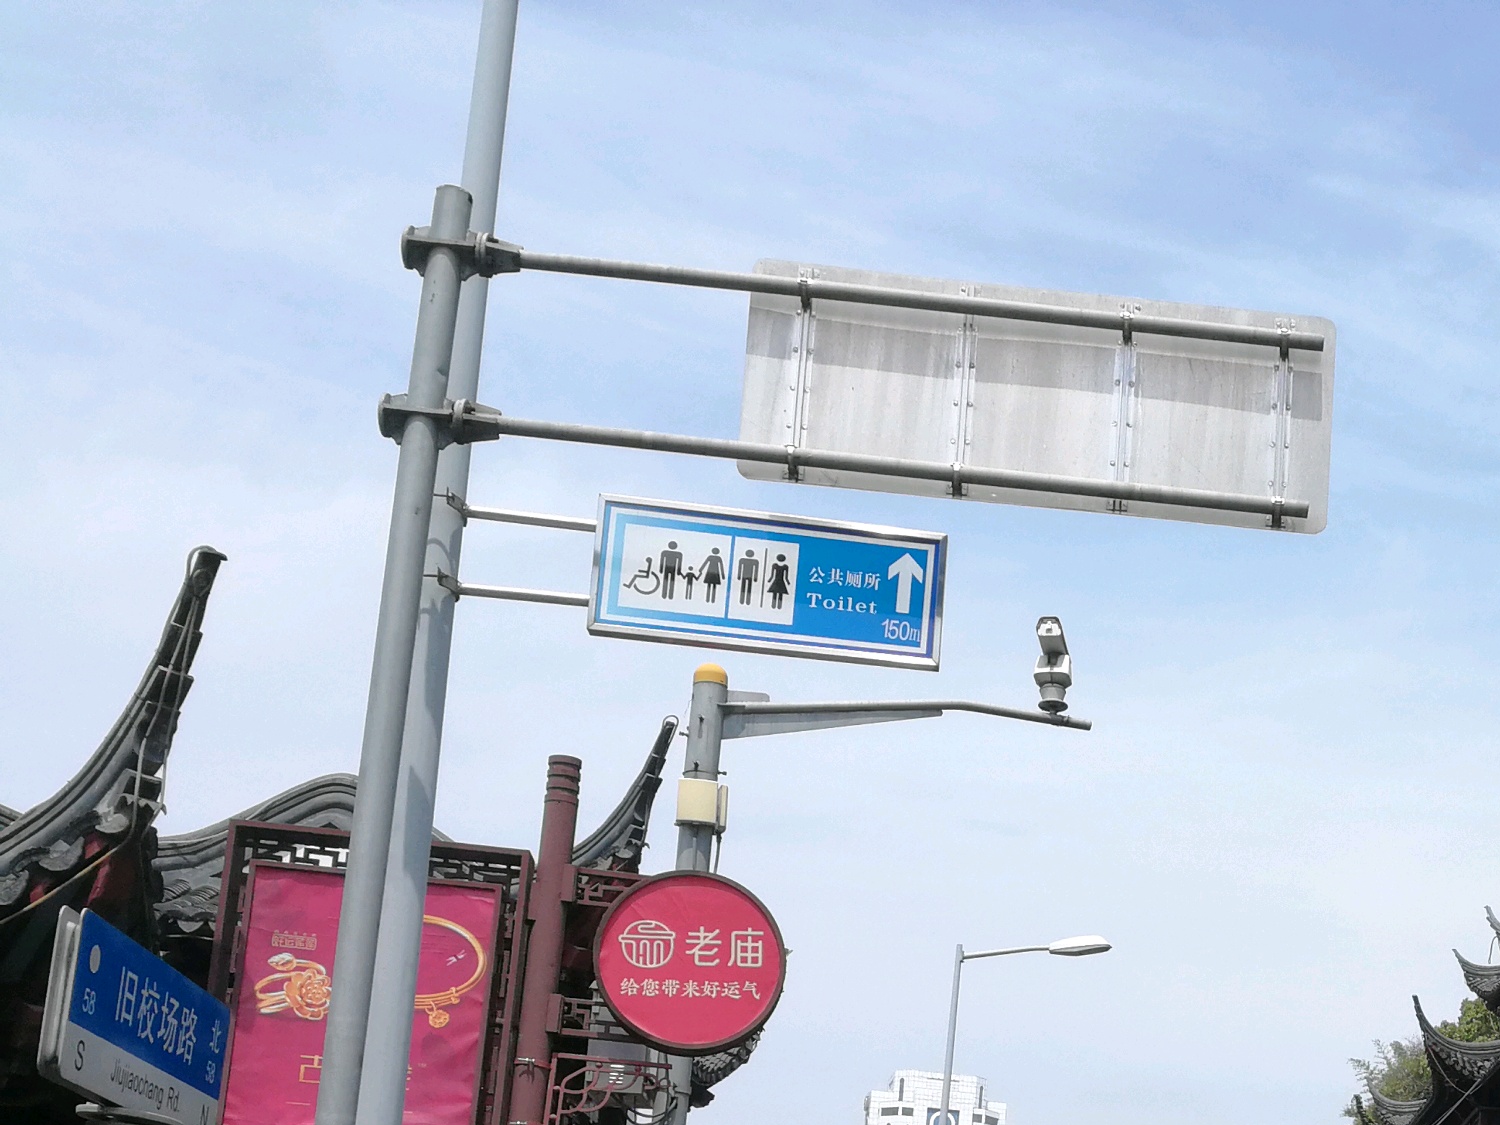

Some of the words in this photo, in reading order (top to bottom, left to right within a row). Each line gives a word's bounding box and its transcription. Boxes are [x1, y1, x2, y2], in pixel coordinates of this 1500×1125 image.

[808, 566, 881, 591] 公共厕所
[806, 592, 878, 615] Toilet
[881, 618, 921, 642] 150m
[685, 925, 764, 968] 老庙
[82, 987, 97, 1016] 58
[619, 977, 761, 1000] 给您带来好运气
[114, 966, 198, 1066] 旧校场路
[208, 1019, 222, 1054] 北
[74, 1039, 86, 1071] S
[110, 1058, 164, 1110] Jiujiaochang
[166, 1086, 181, 1113] Rd.
